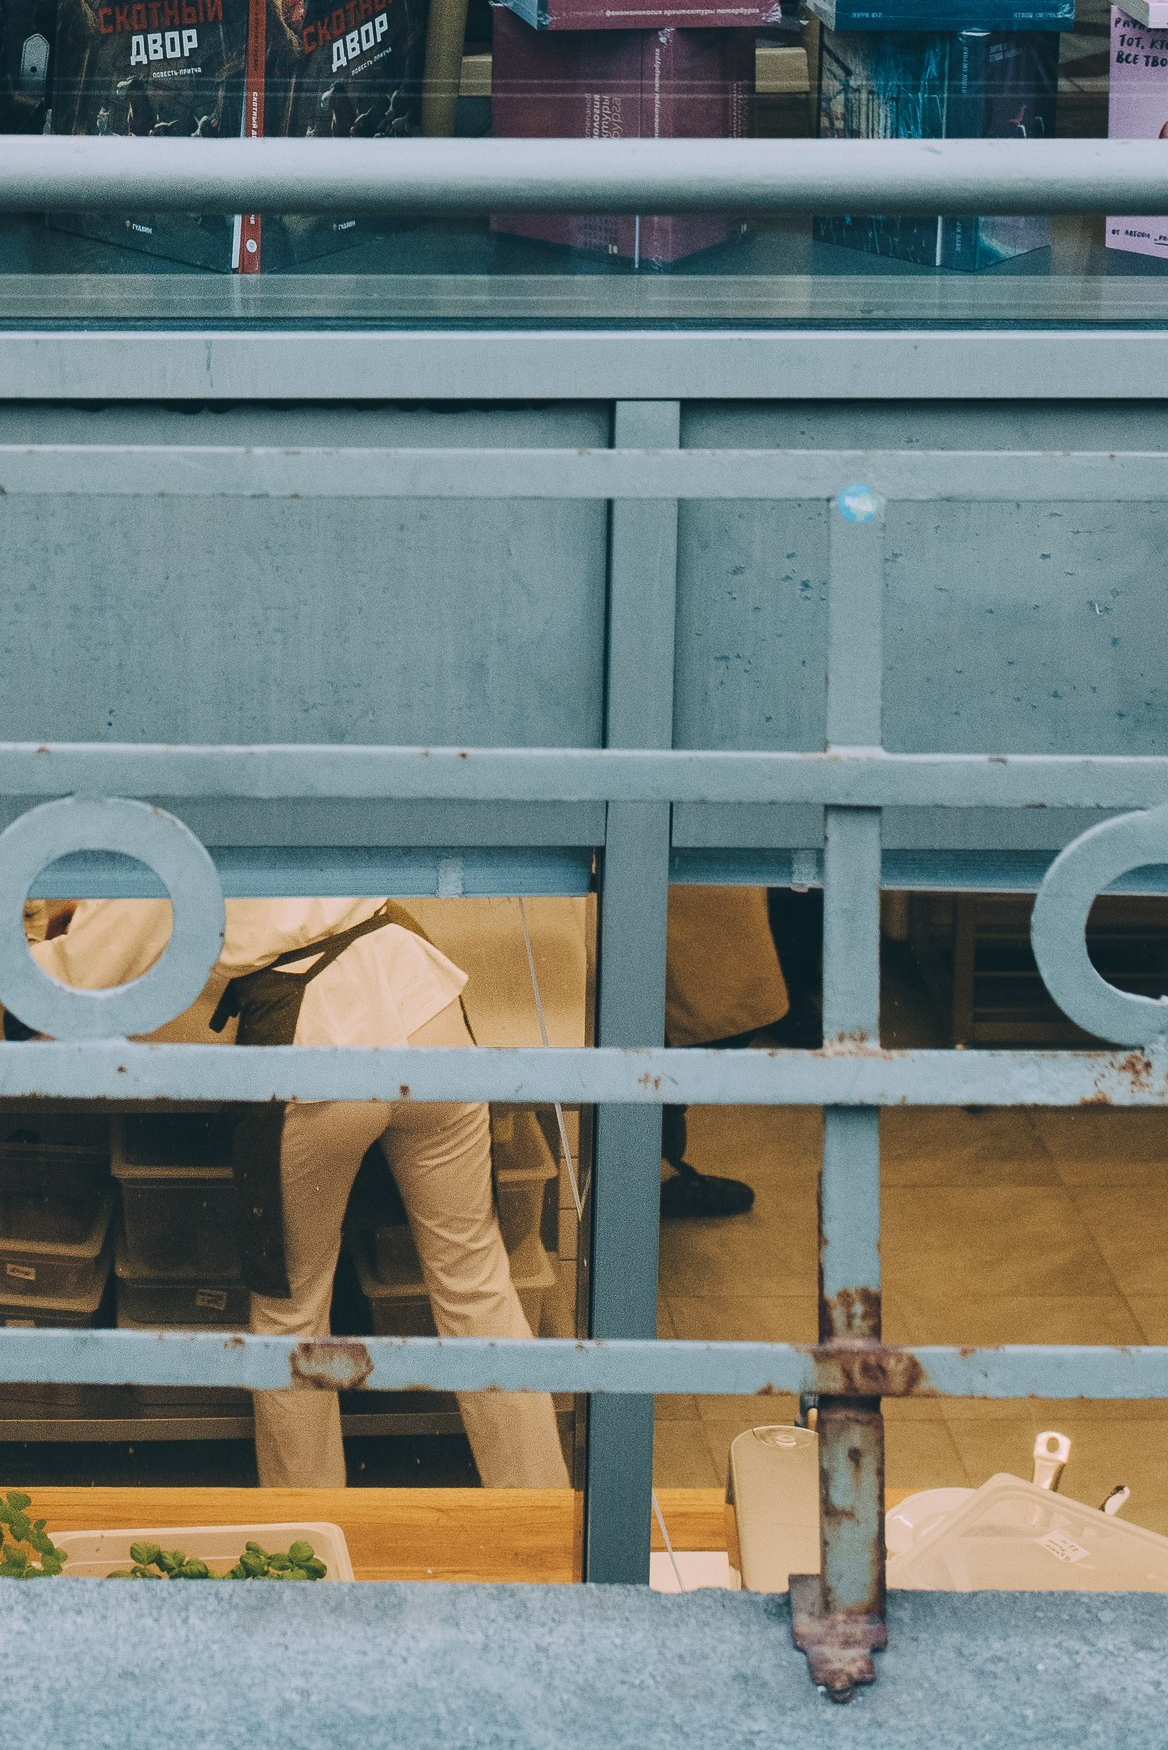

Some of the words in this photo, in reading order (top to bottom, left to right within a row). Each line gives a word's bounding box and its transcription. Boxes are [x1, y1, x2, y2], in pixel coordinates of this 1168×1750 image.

[664, 7, 715, 17] архитектуры
[716, 6, 760, 16] петербурга
[130, 29, 198, 66] ДВОР
[332, 13, 389, 73] ДВОР
[1120, 33, 1145, 49] ТОТ,
[1117, 49, 1141, 64] ВСЕ
[1145, 53, 1168, 68] ТВО
[152, 67, 202, 78] ПОВЕСТЬ-ПРИТЧА
